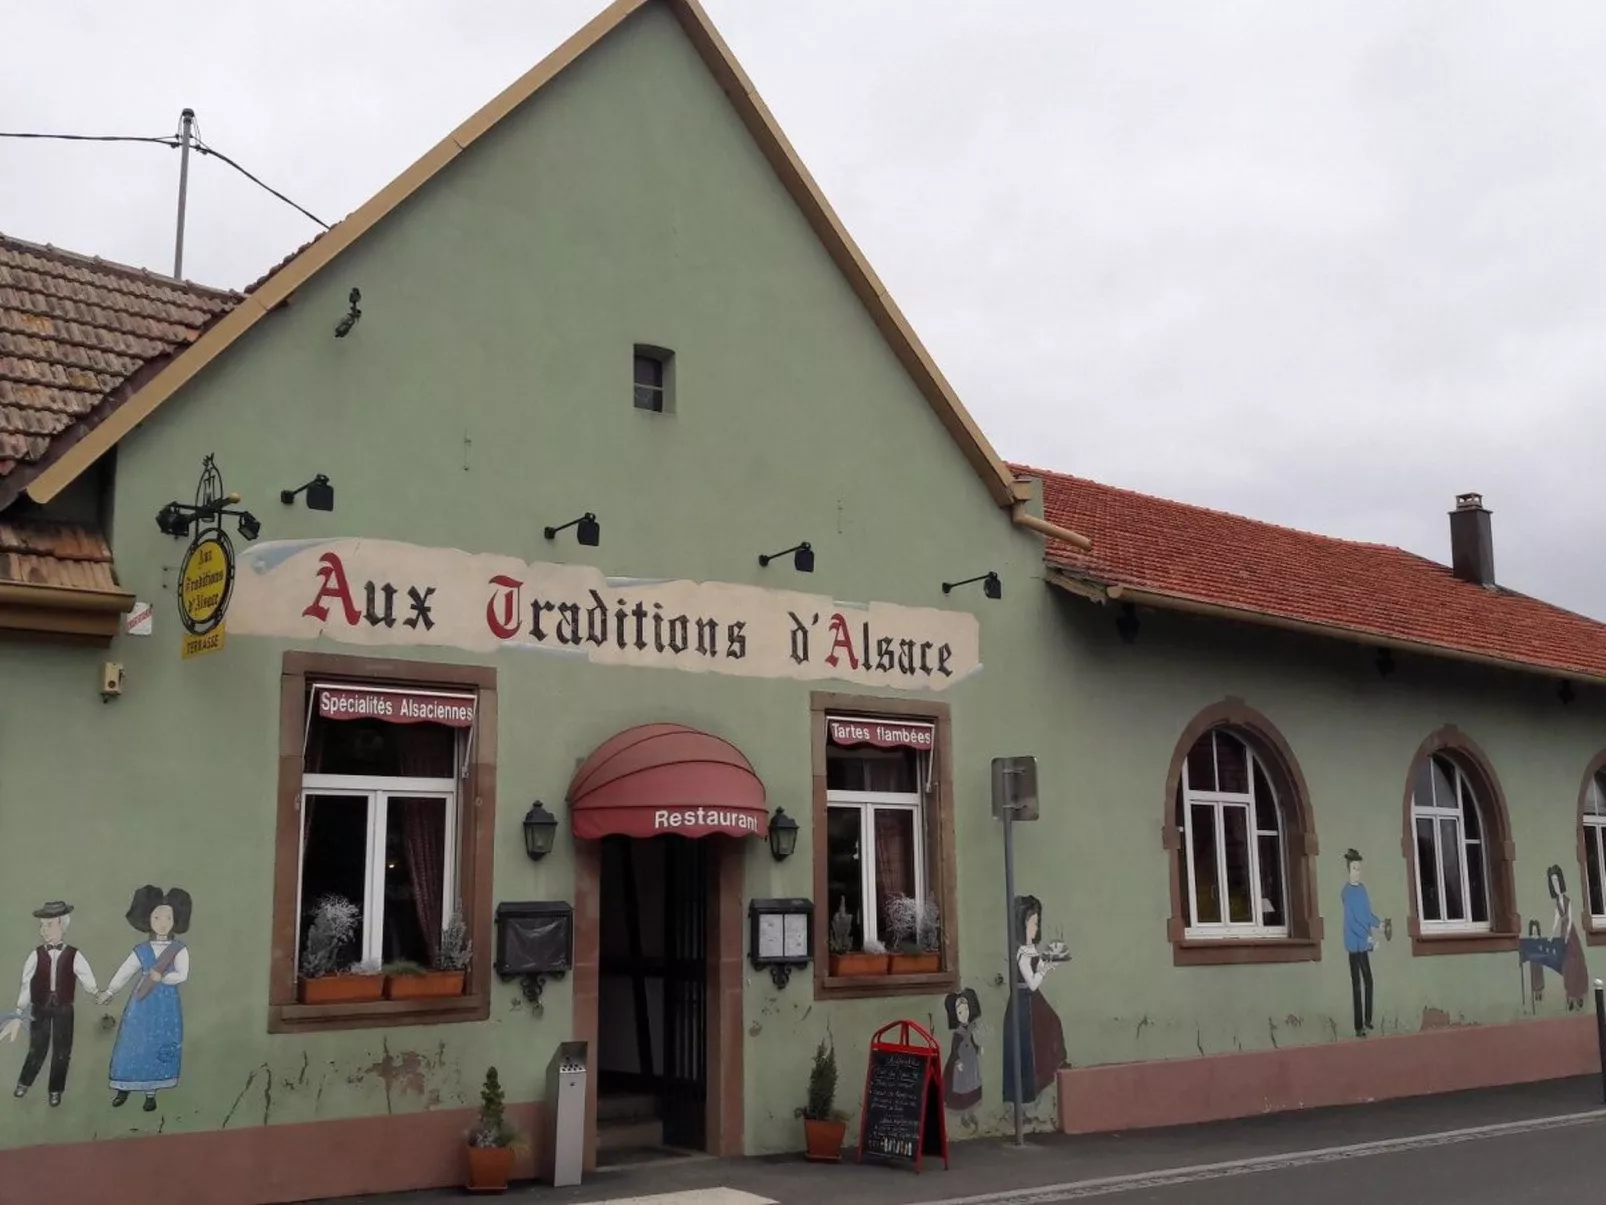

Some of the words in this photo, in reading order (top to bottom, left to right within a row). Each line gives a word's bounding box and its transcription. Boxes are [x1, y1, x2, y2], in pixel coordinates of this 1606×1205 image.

[302, 552, 436, 631] Aux
[486, 575, 747, 660] Traditions
[788, 611, 954, 677] d'Alsace
[187, 635, 219, 655] TERRASSE
[321, 691, 393, 715] Spécialités
[400, 698, 473, 722] Alsaciennes
[832, 723, 870, 740] Tartes
[876, 726, 931, 744] flambées
[655, 807, 758, 832] Restaurant
